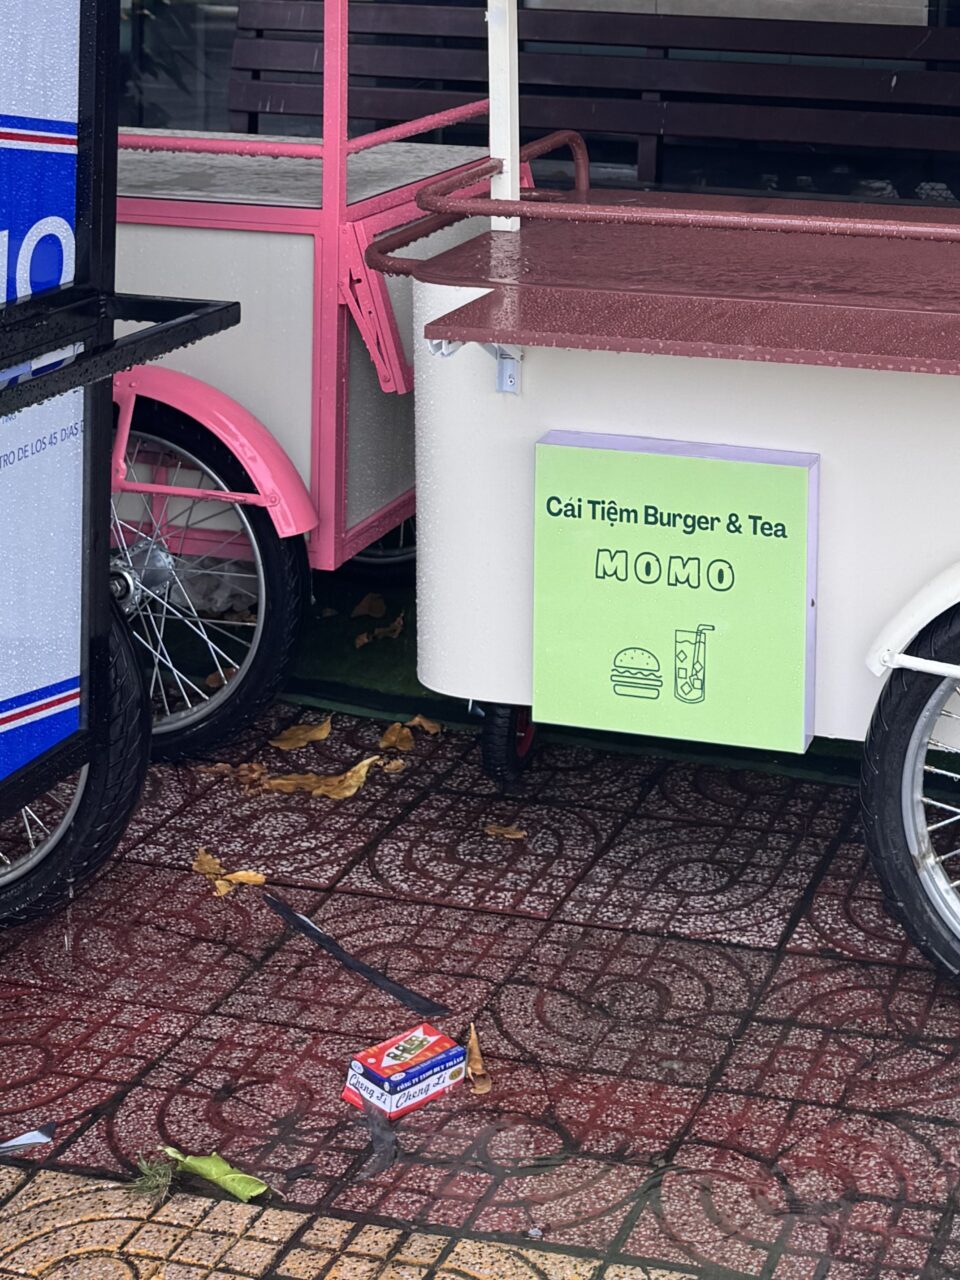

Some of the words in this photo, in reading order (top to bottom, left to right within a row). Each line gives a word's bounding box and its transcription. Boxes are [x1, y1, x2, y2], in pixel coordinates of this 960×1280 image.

[17, 444, 29, 462] DE
[30, 436, 47, 456] LOS
[48, 431, 58, 447] 45
[546, 495, 582, 519] Cái
[587, 500, 638, 527] Tiệm
[644, 505, 721, 535] Burger
[726, 513, 743, 534] &
[748, 514, 788, 538] Tea
[595, 548, 735, 591] MOMO
[396, 1083, 431, 1109] Cheng
